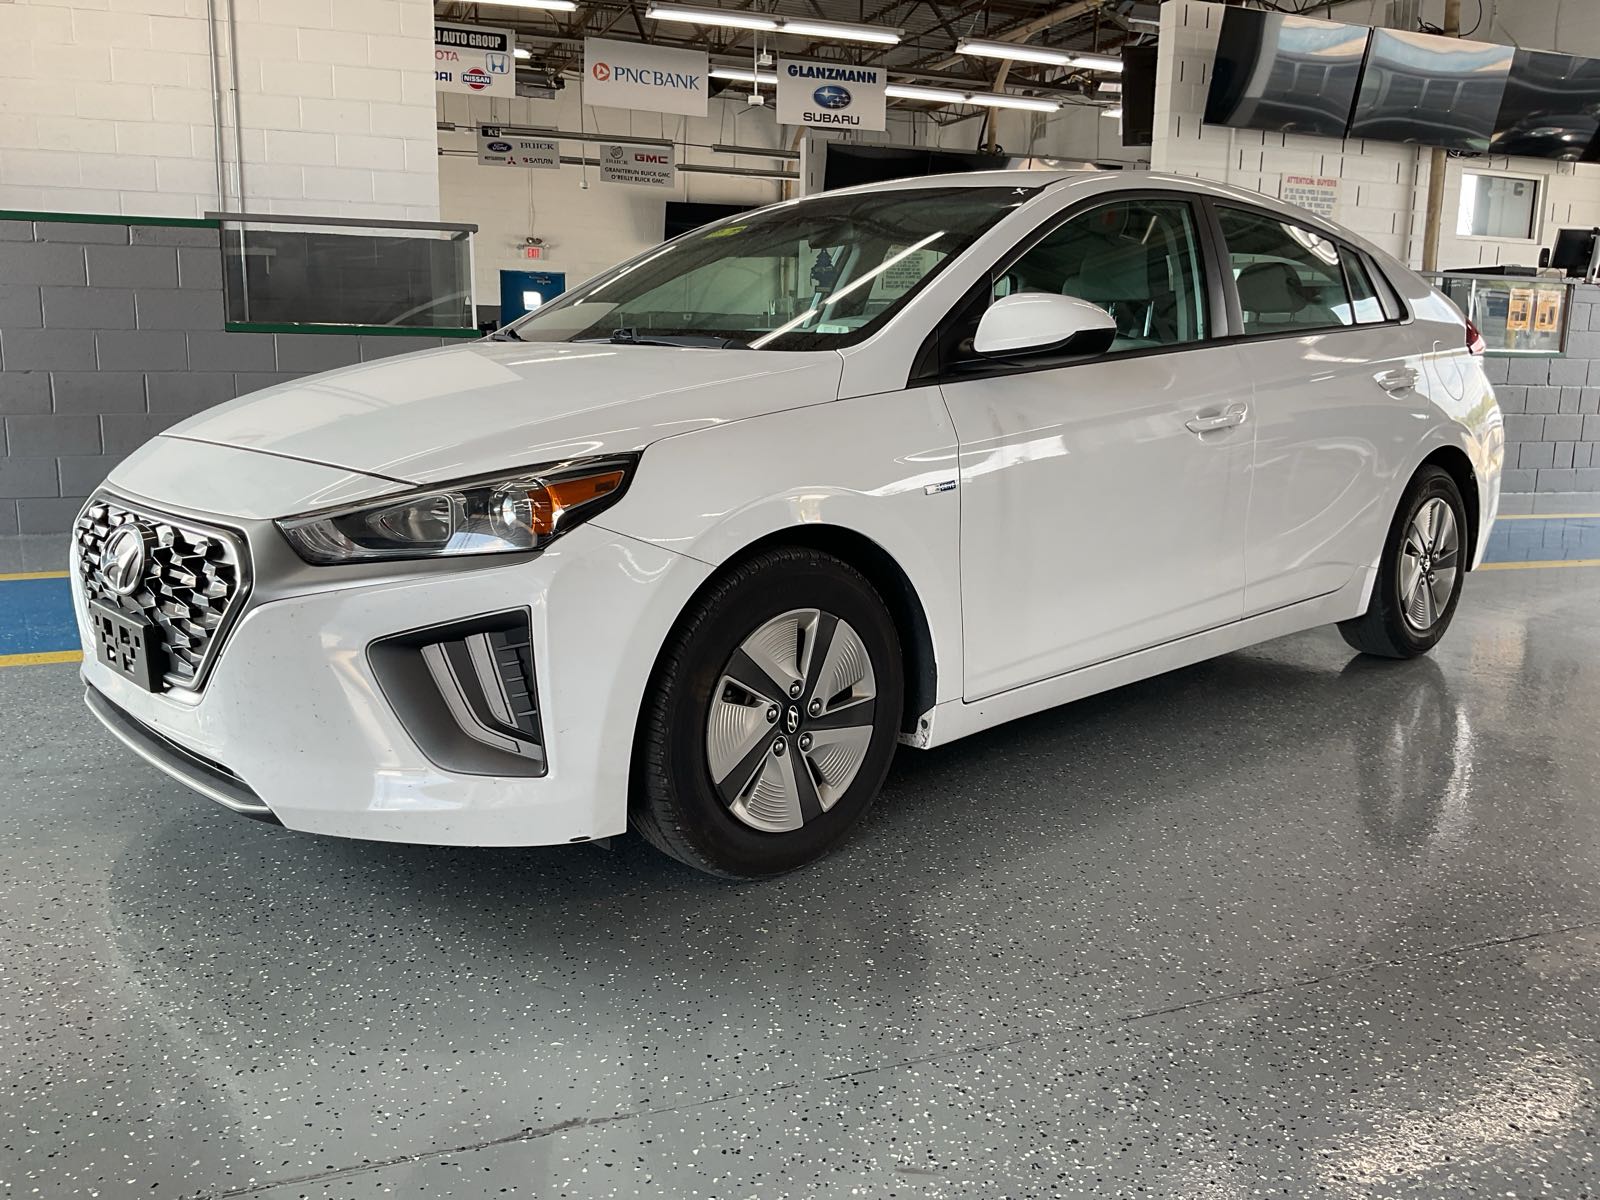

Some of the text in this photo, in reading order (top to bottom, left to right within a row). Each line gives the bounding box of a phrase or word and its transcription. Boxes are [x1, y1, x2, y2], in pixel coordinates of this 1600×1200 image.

[442, 30, 467, 45] AUTO
[468, 33, 501, 49] GROUP
[463, 75, 490, 84] NISSAN
[787, 64, 877, 84] GLANZMANN
[803, 112, 860, 125] SUBARU
[529, 157, 554, 165] SATURN
[634, 153, 669, 165] GMC
